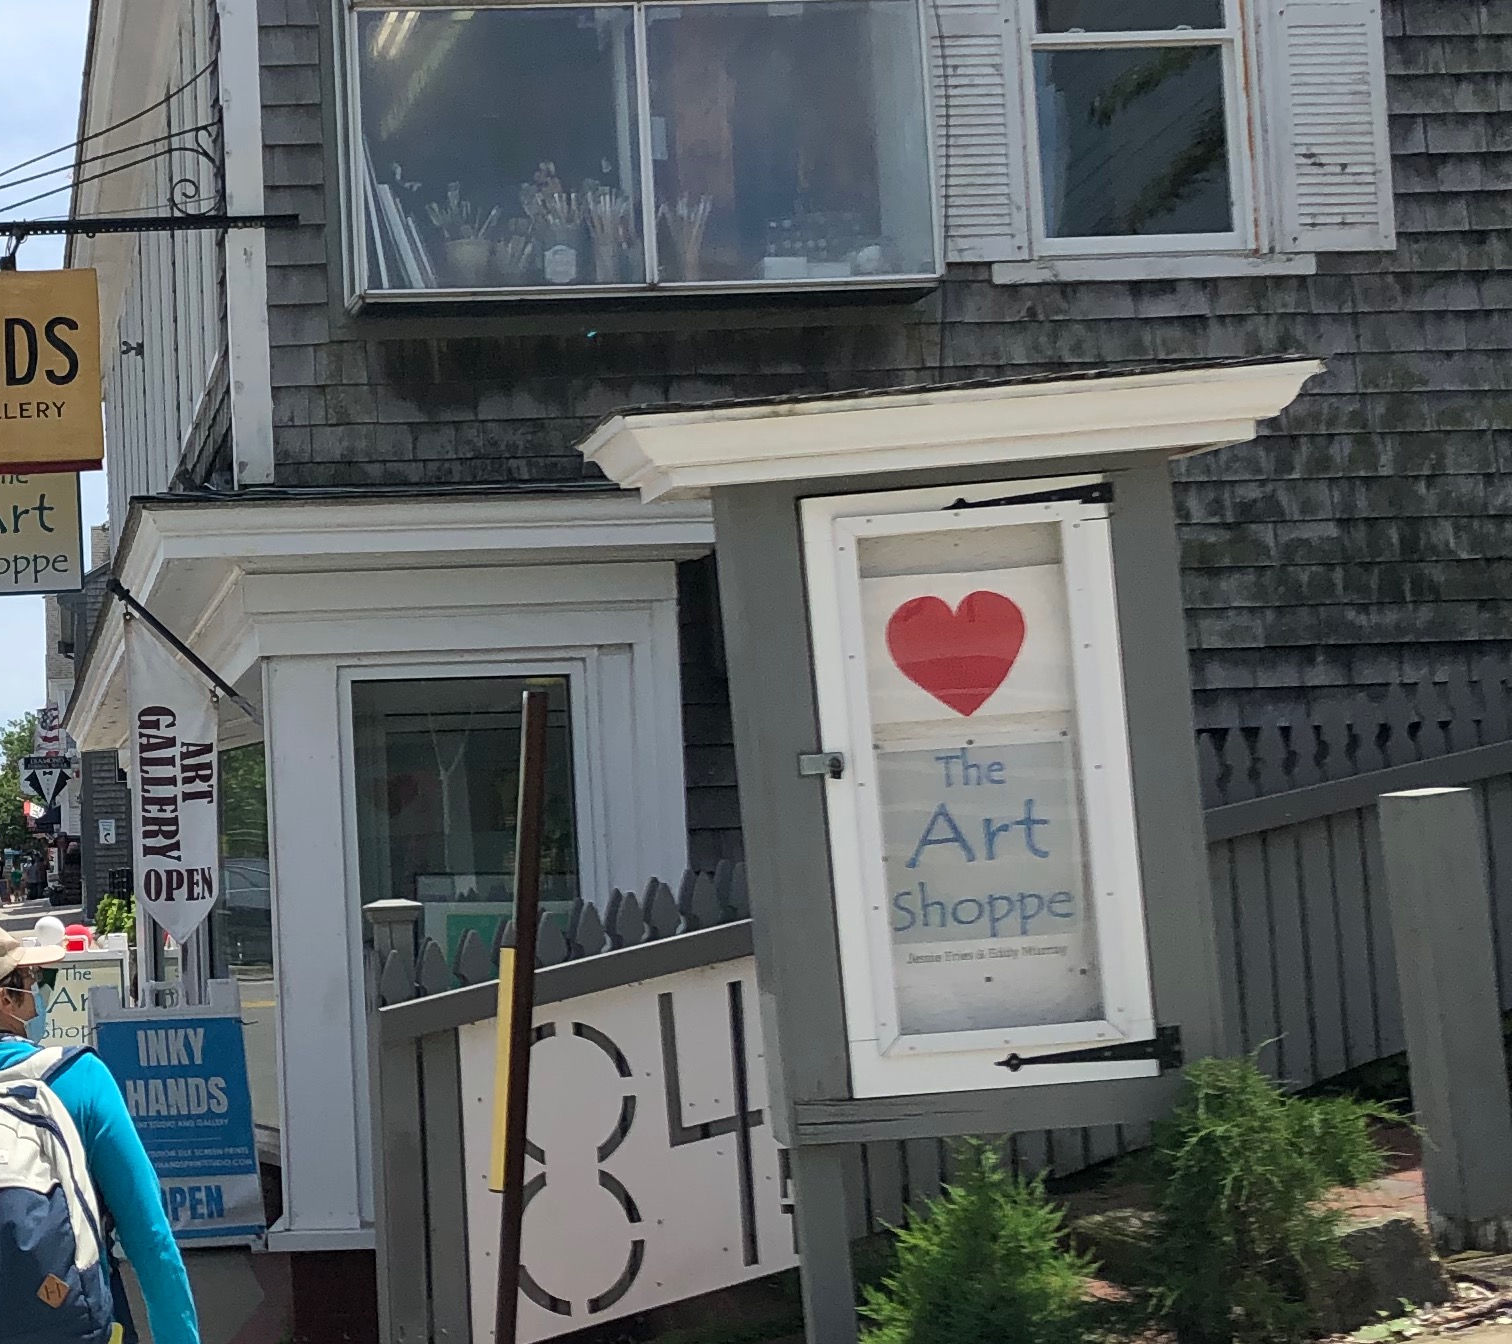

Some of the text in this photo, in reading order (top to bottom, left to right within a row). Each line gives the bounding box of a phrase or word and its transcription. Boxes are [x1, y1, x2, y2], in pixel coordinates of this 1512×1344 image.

[137, 705, 182, 862] GALLERY
[180, 741, 214, 804] ART
[934, 747, 1007, 788] The
[905, 799, 1050, 869] Art
[143, 866, 214, 902] OPEN
[893, 881, 1074, 938] Shoppe
[64, 964, 92, 982] The
[47, 986, 89, 1014] Ar
[137, 1027, 205, 1067] INKY
[125, 1077, 228, 1117] HANDS
